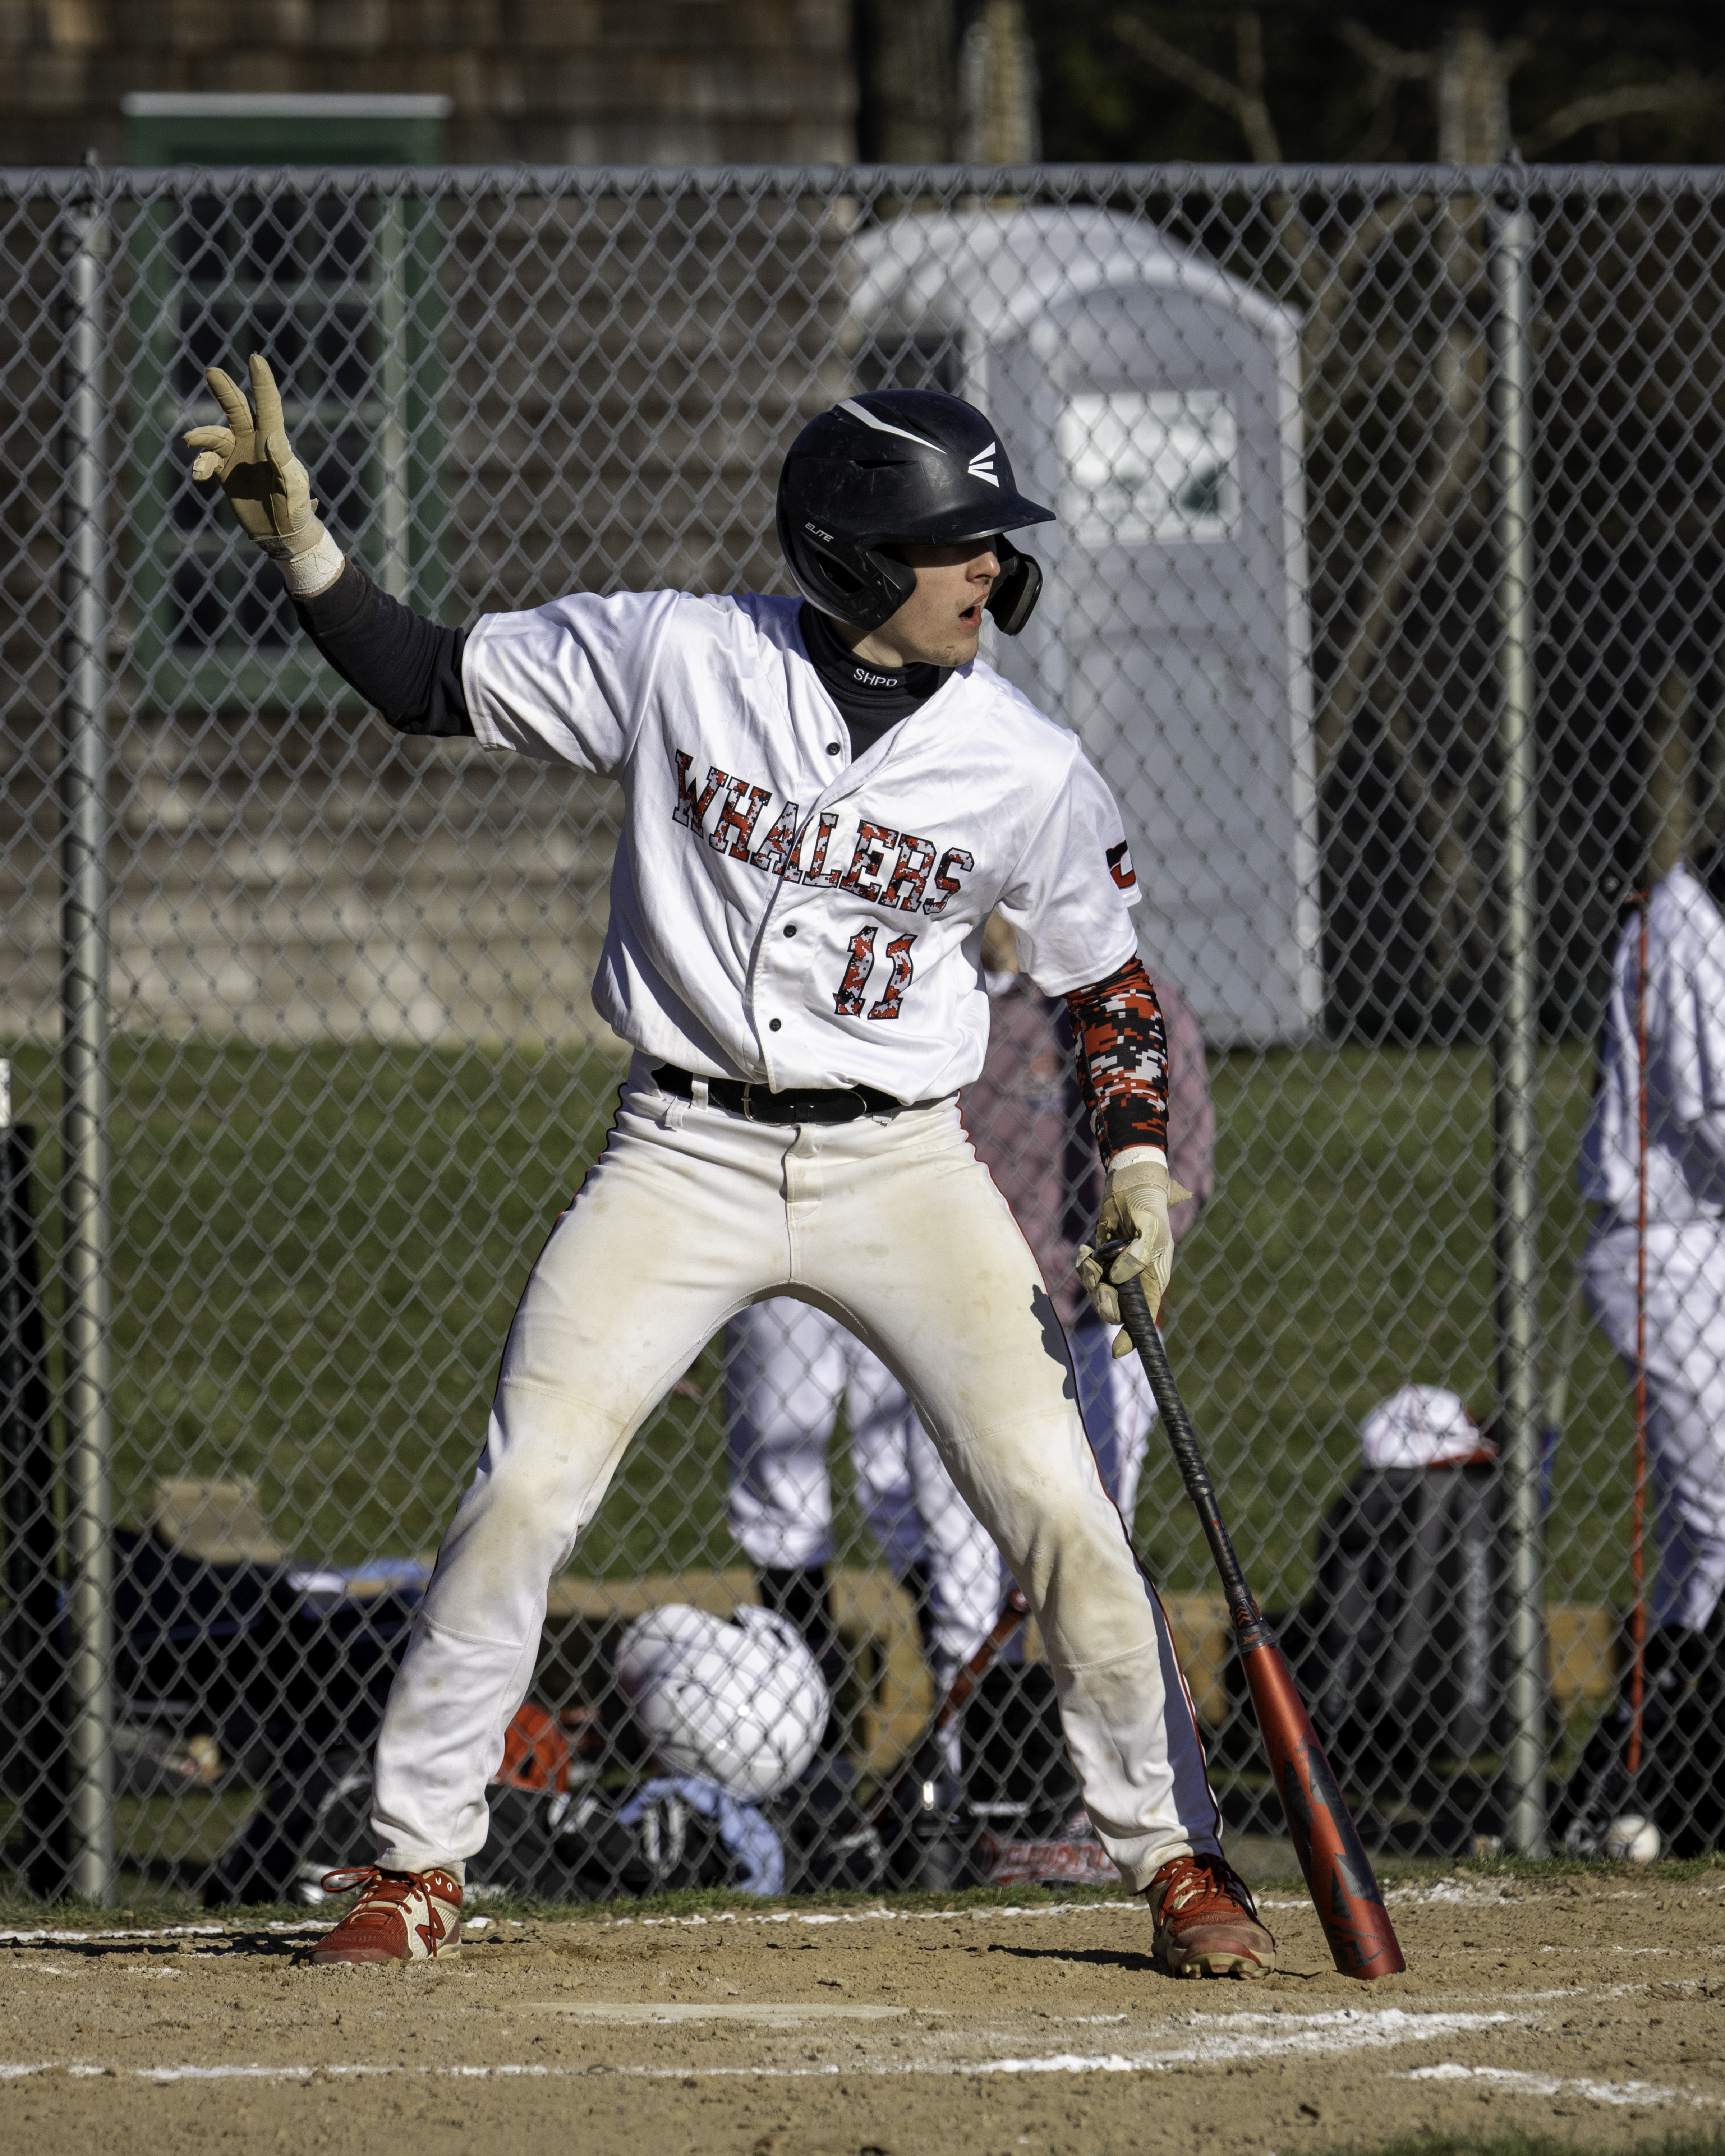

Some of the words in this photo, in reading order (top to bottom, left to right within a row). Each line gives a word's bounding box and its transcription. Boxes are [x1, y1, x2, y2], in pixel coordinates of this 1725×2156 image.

[805, 522, 834, 542] ELITE
[854, 668, 897, 686] SHPD
[672, 748, 974, 915] WHALERS
[832, 925, 918, 1020] 11
